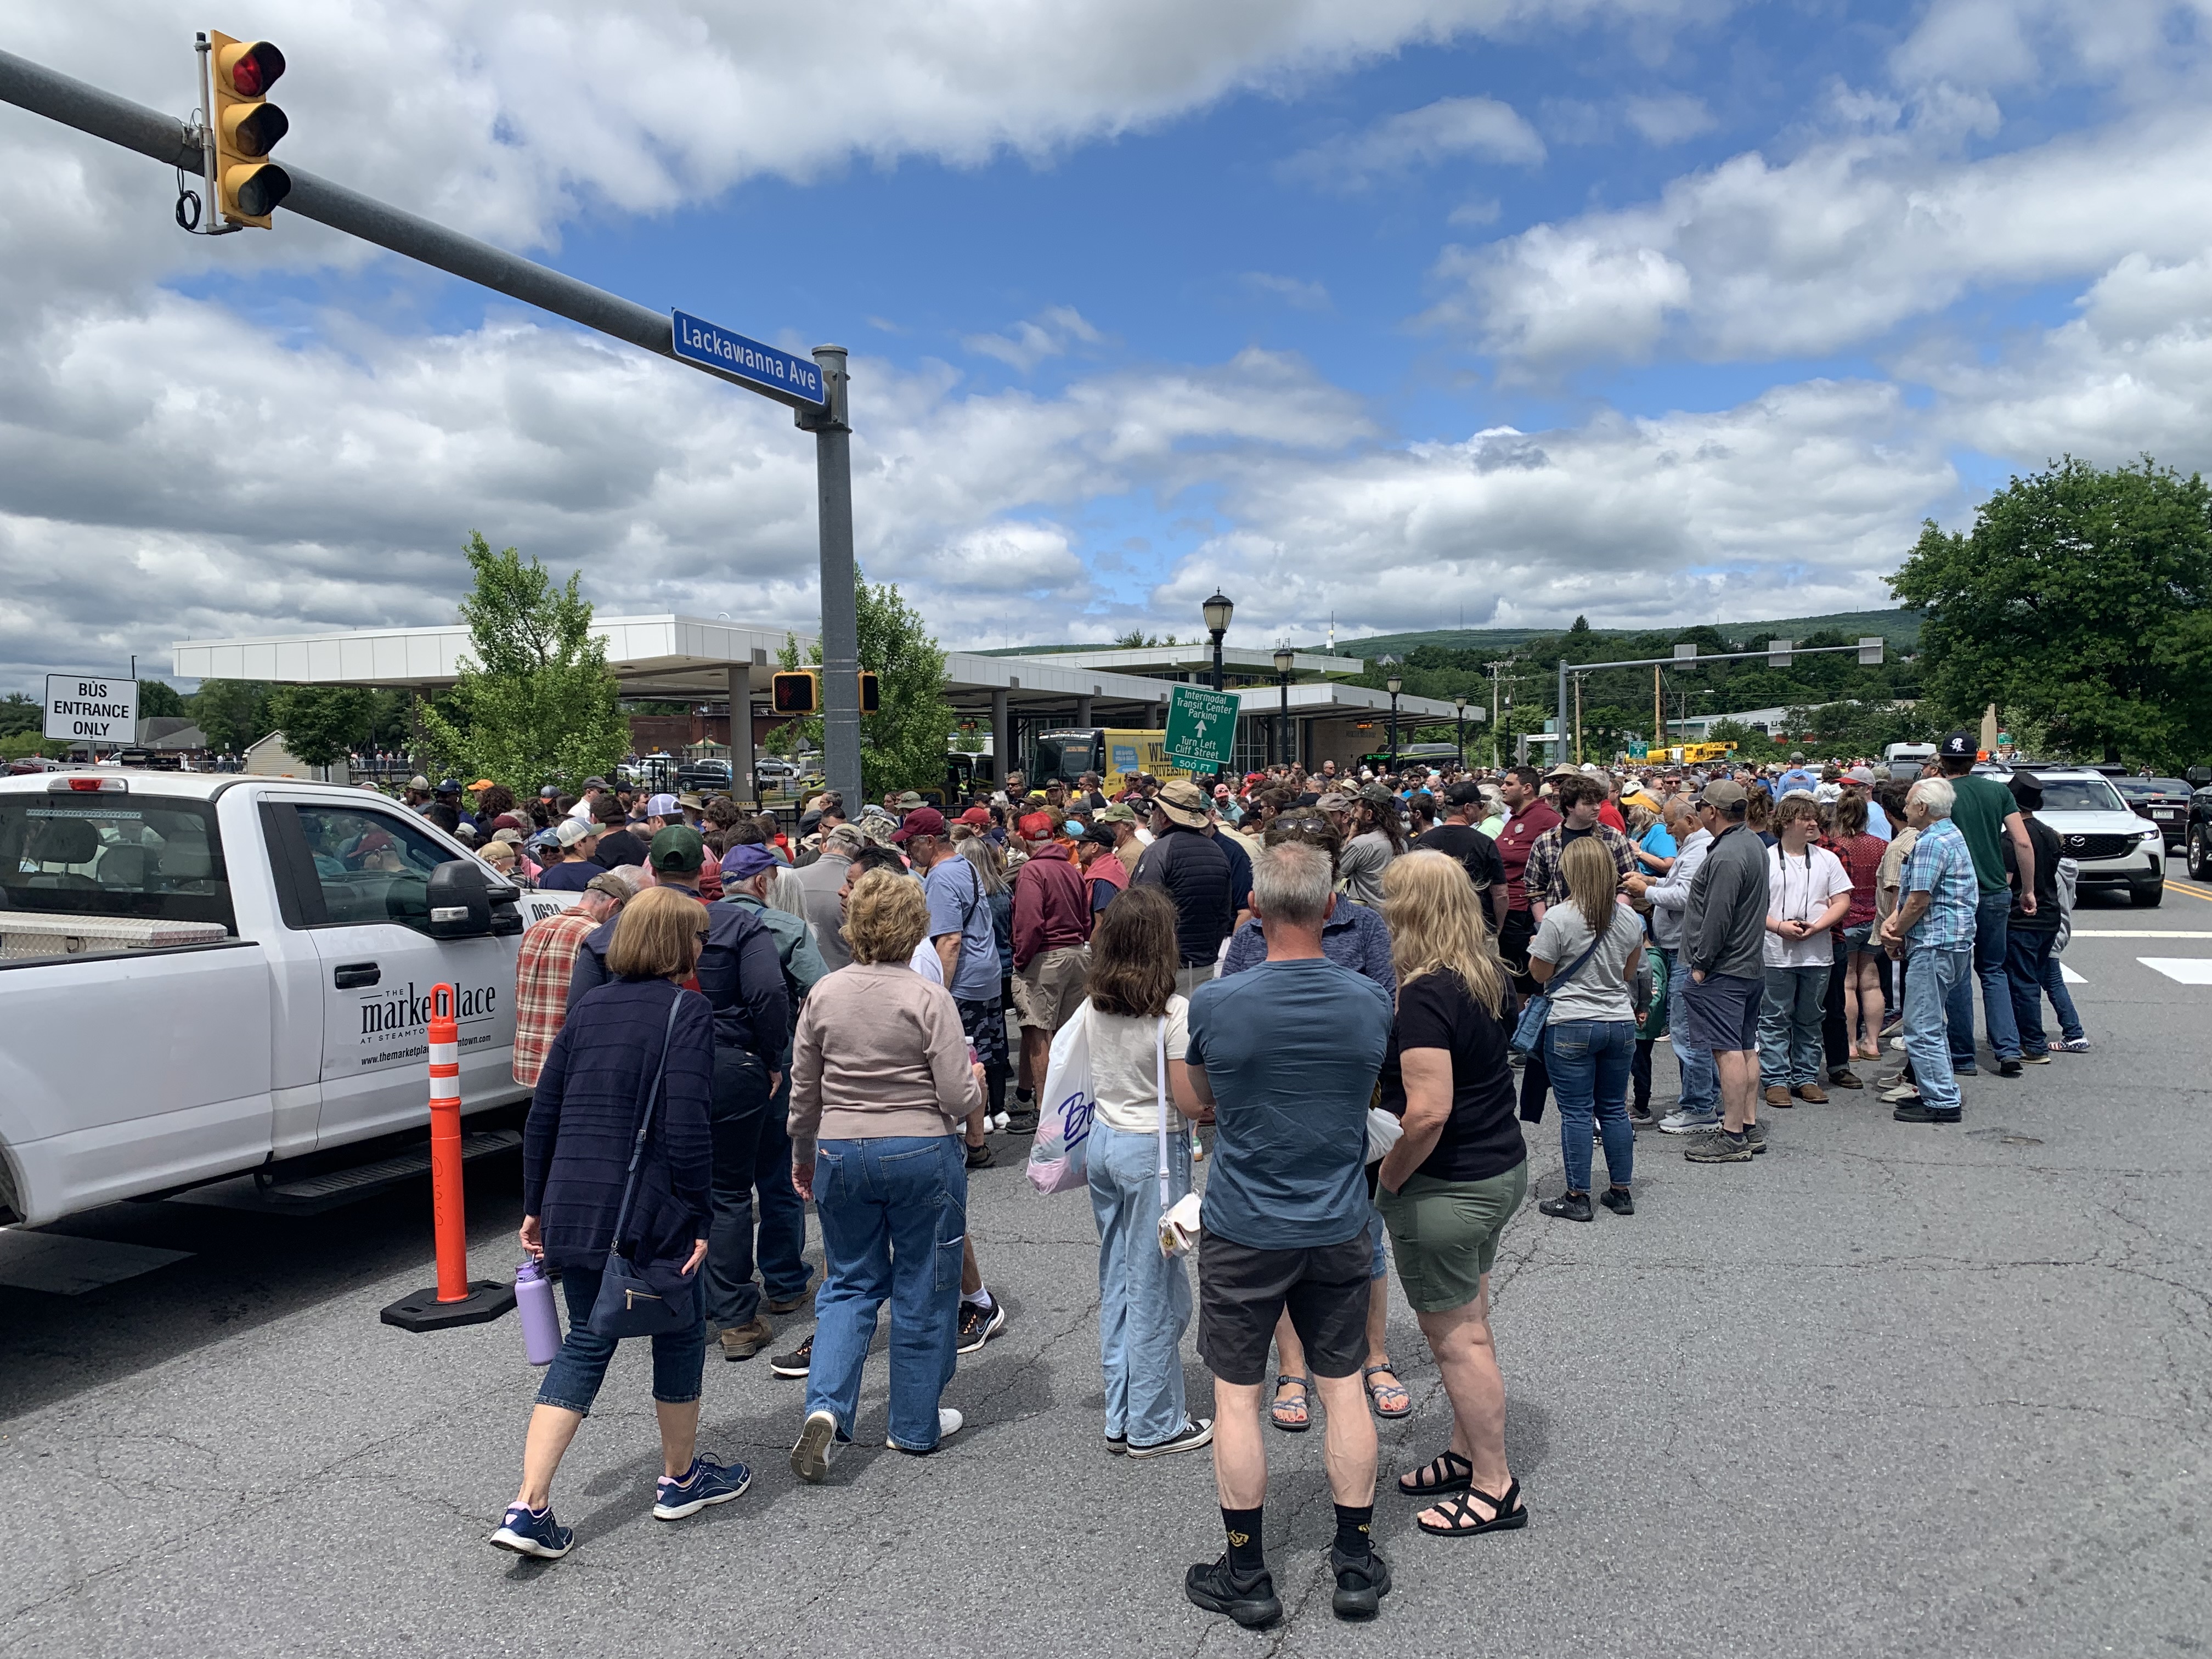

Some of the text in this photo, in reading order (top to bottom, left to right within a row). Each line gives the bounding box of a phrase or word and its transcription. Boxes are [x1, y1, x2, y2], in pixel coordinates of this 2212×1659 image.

[682, 319, 816, 390] Lackawanna Ave
[78, 682, 107, 698] BUS
[1184, 690, 1227, 704] Intermodal
[54, 701, 129, 718] ENTRANCE
[1177, 697, 1233, 714] Transit Center
[1188, 709, 1217, 724] Parking
[74, 721, 110, 736] ONLY
[1181, 736, 1216, 750] Turn Left
[1175, 744, 1219, 759] Cliff Street
[1180, 760, 1197, 769] 500
[385, 989, 404, 997] THE
